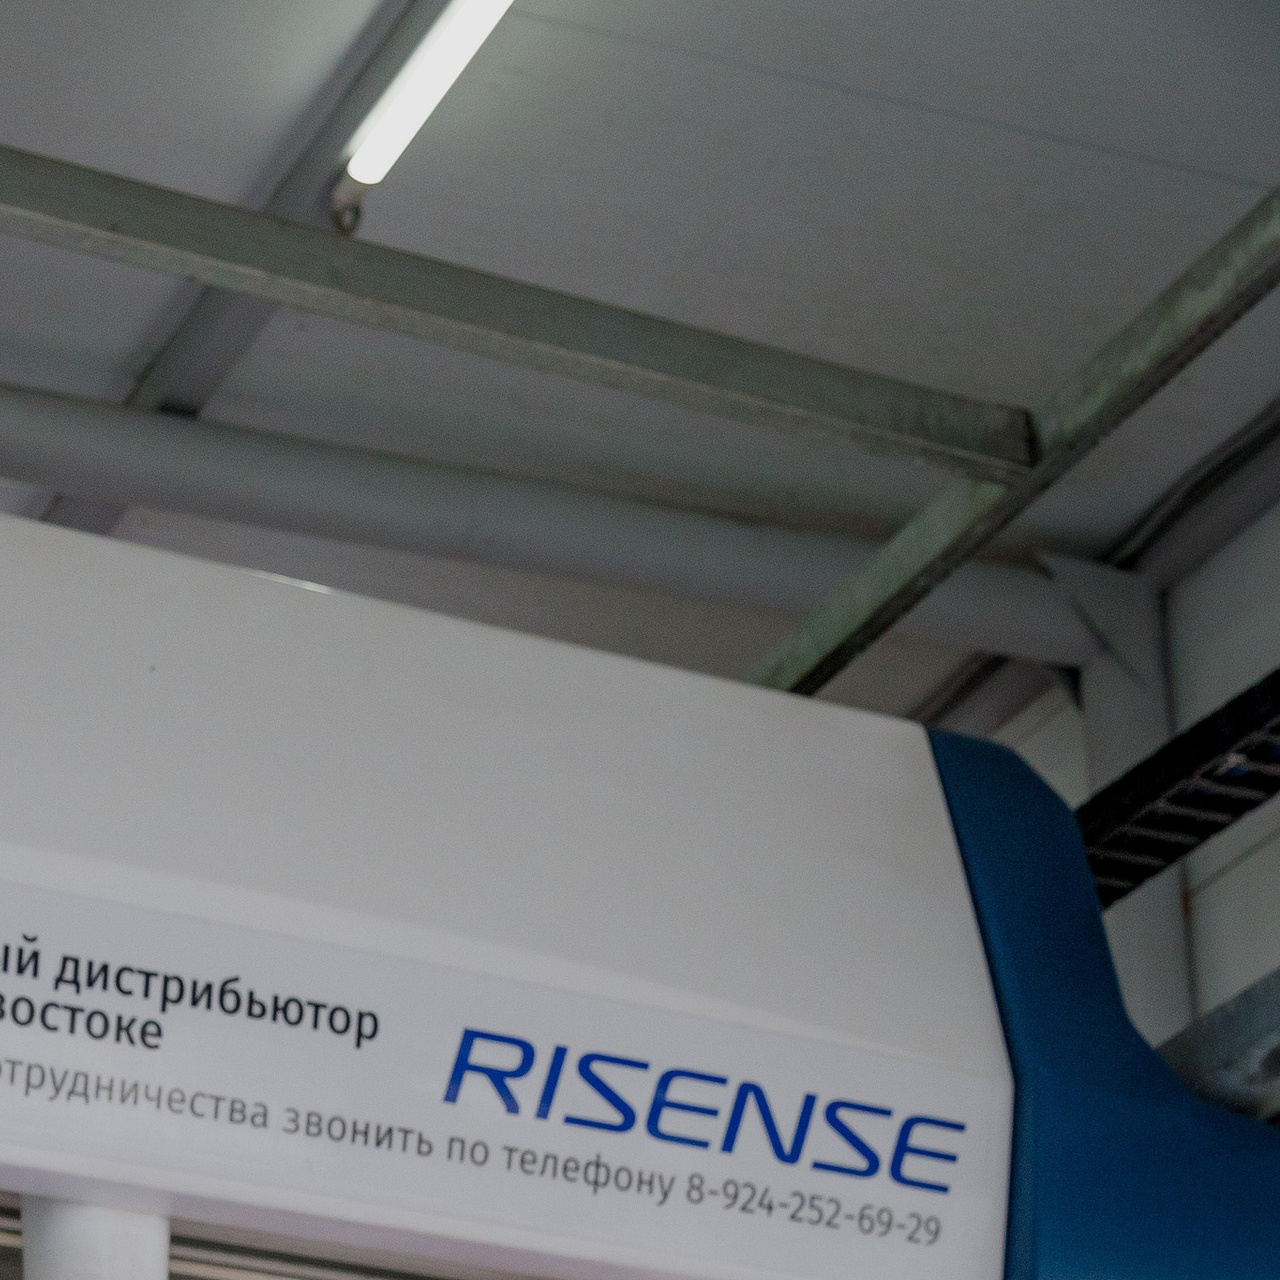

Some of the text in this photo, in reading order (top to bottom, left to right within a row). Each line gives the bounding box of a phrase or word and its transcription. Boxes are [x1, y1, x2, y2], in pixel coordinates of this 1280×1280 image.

[53, 953, 381, 1051] дистрибьютор
[282, 1106, 435, 1158] звонить
[446, 1135, 491, 1168] по
[502, 1144, 676, 1208] телефону
[685, 1173, 943, 1246] 8-924-252-69-29
[441, 1027, 968, 1196] RISENSE
